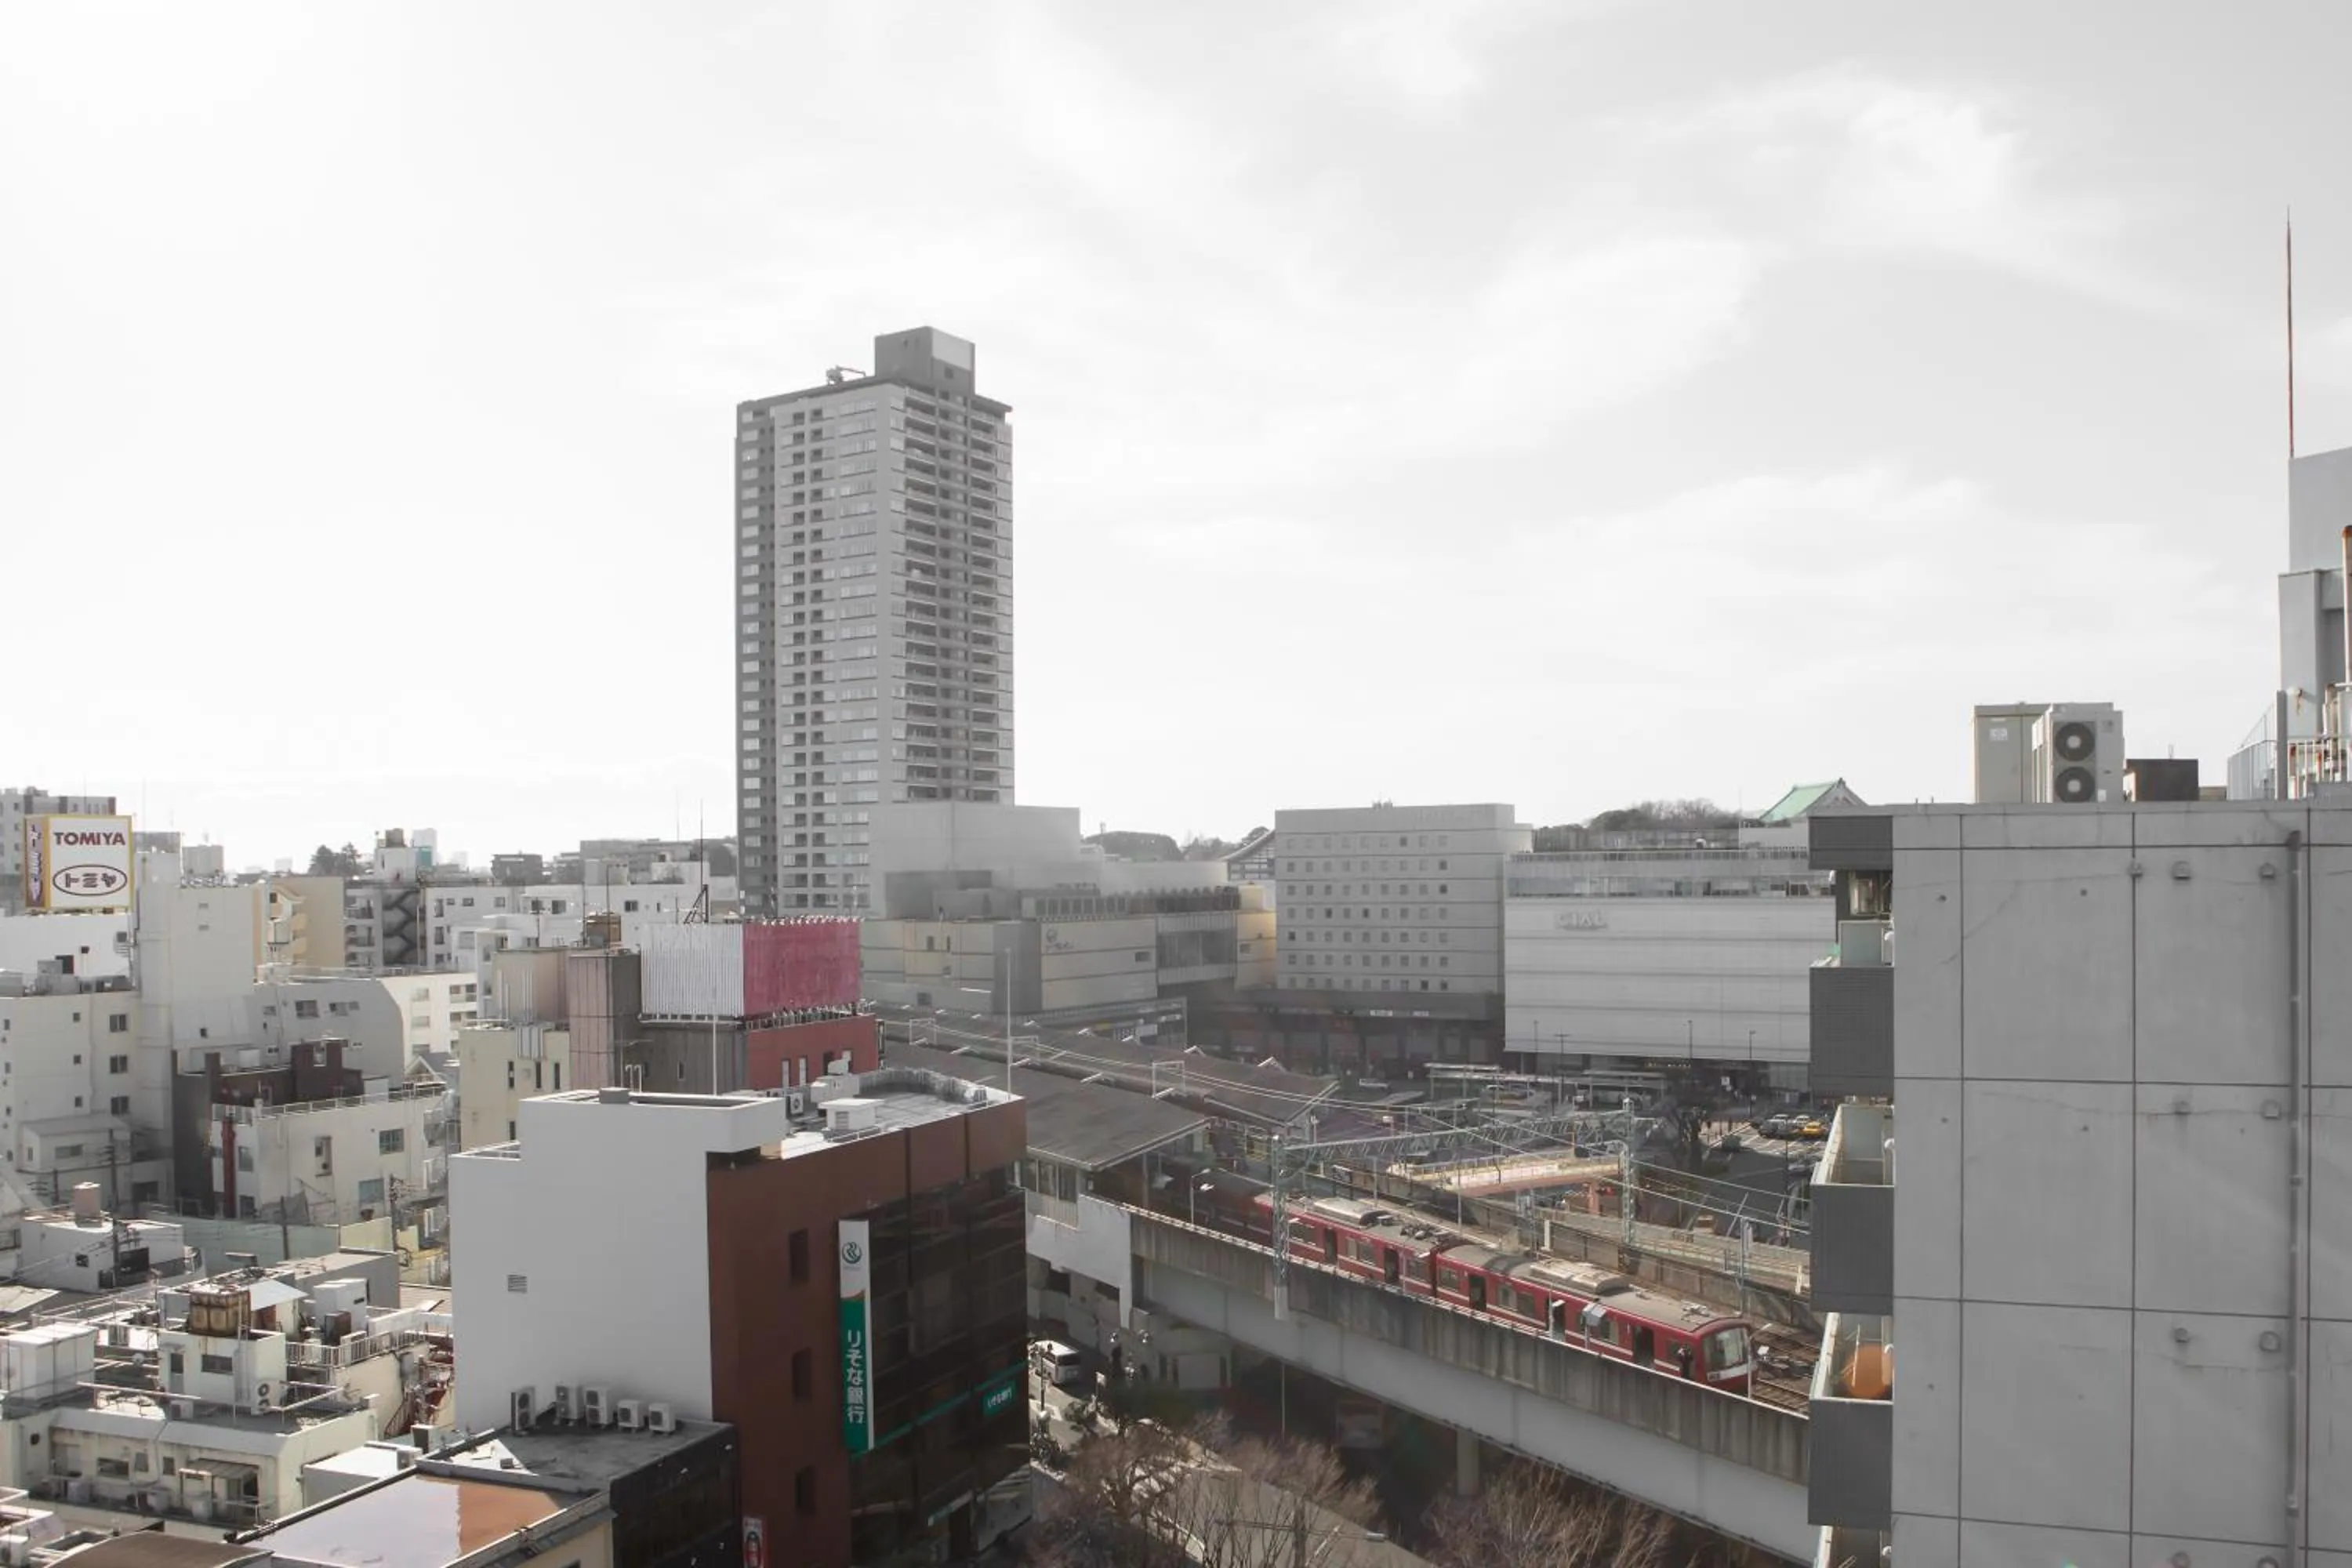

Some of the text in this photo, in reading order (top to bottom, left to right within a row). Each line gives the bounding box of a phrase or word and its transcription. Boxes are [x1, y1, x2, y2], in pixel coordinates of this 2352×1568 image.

[53, 832, 125, 845] TOMIYA
[65, 873, 117, 887] トミヤ
[846, 1330, 865, 1425] りそな銀行
